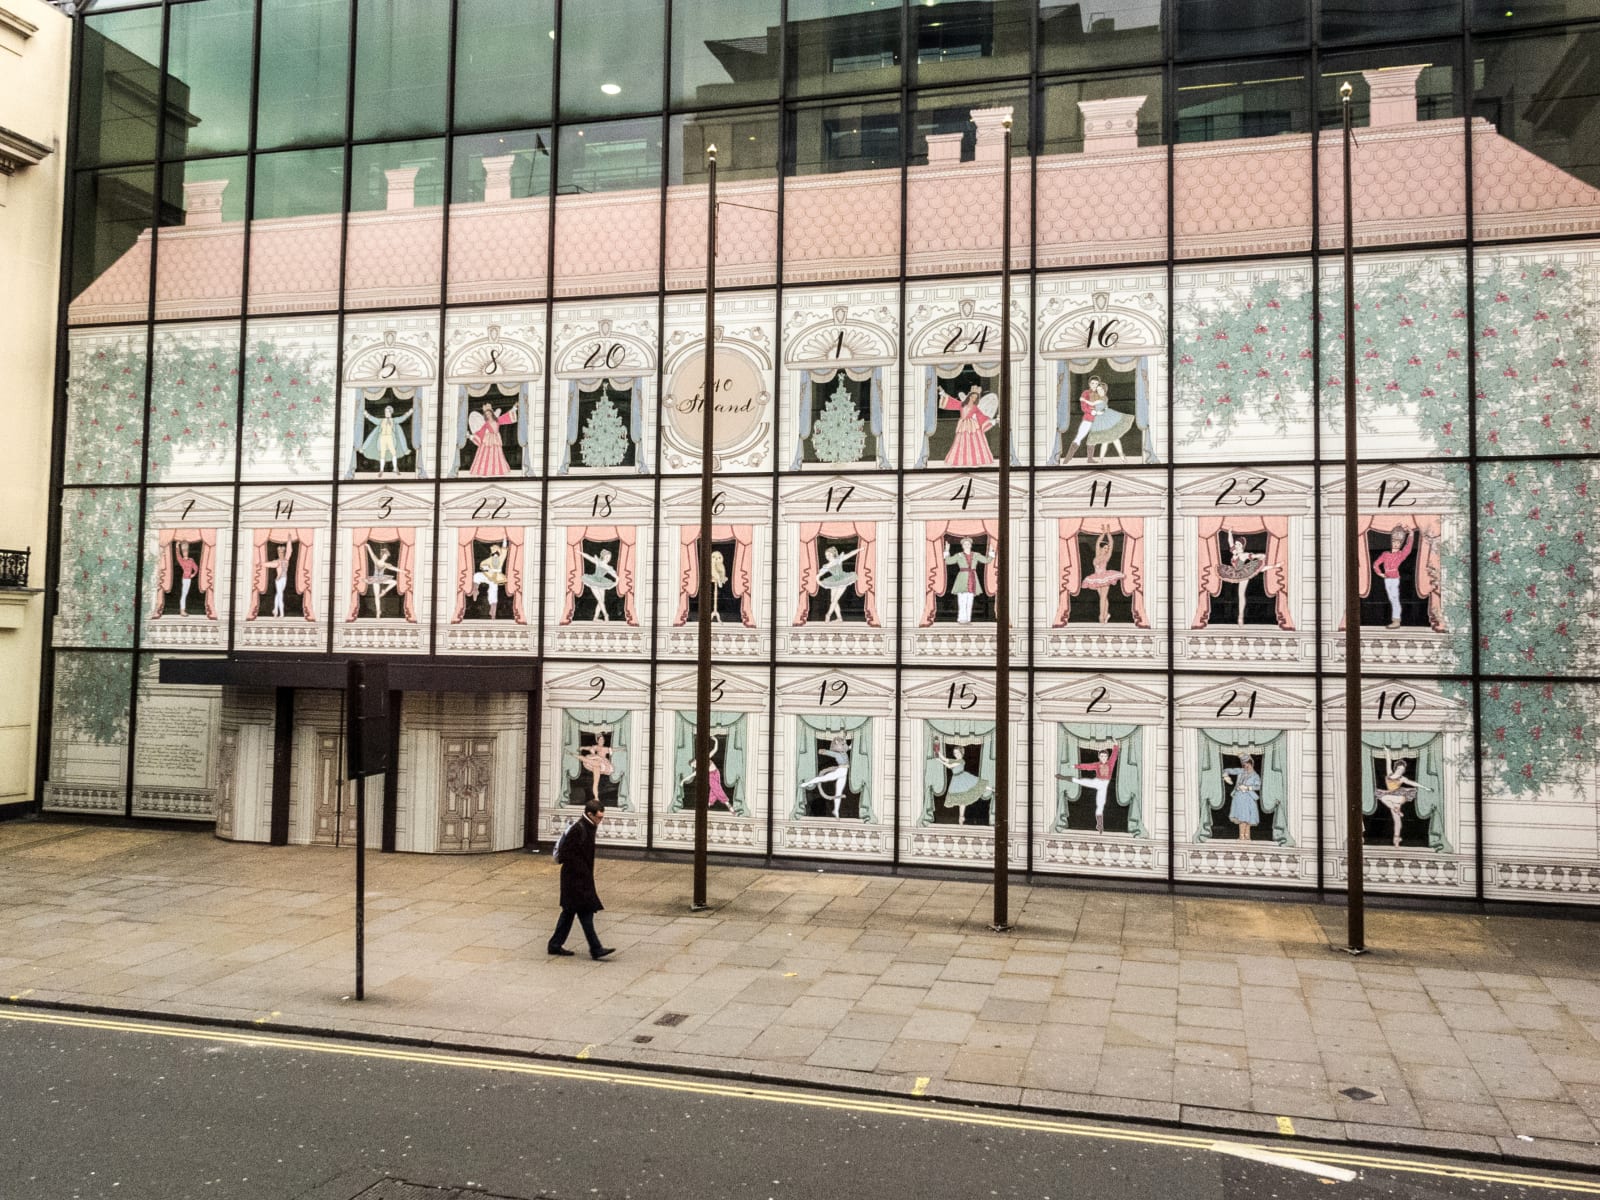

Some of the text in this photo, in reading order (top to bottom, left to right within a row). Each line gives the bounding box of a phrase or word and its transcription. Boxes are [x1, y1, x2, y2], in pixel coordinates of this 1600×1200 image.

[835, 331, 844, 359] 1
[943, 325, 989, 353] 24
[1086, 319, 1120, 348] 16
[380, 354, 396, 379] 5
[484, 344, 503, 375] 8
[583, 343, 626, 370] 20
[676, 393, 756, 415] Stand
[592, 489, 618, 518] 18
[711, 490, 727, 516] 6
[826, 486, 856, 513] 17
[950, 478, 974, 510] 4
[1088, 480, 1113, 507] 11
[1215, 477, 1269, 507] 23
[1378, 479, 1417, 508] 12
[181, 499, 195, 520] 7
[275, 499, 294, 520] 14
[378, 497, 394, 519] 3
[472, 497, 511, 519] 22
[588, 676, 606, 701] 9
[818, 679, 849, 706] 19
[947, 682, 978, 710] 15
[1086, 686, 1113, 714] 2
[1216, 689, 1257, 718] 21
[1376, 690, 1417, 721] 10
